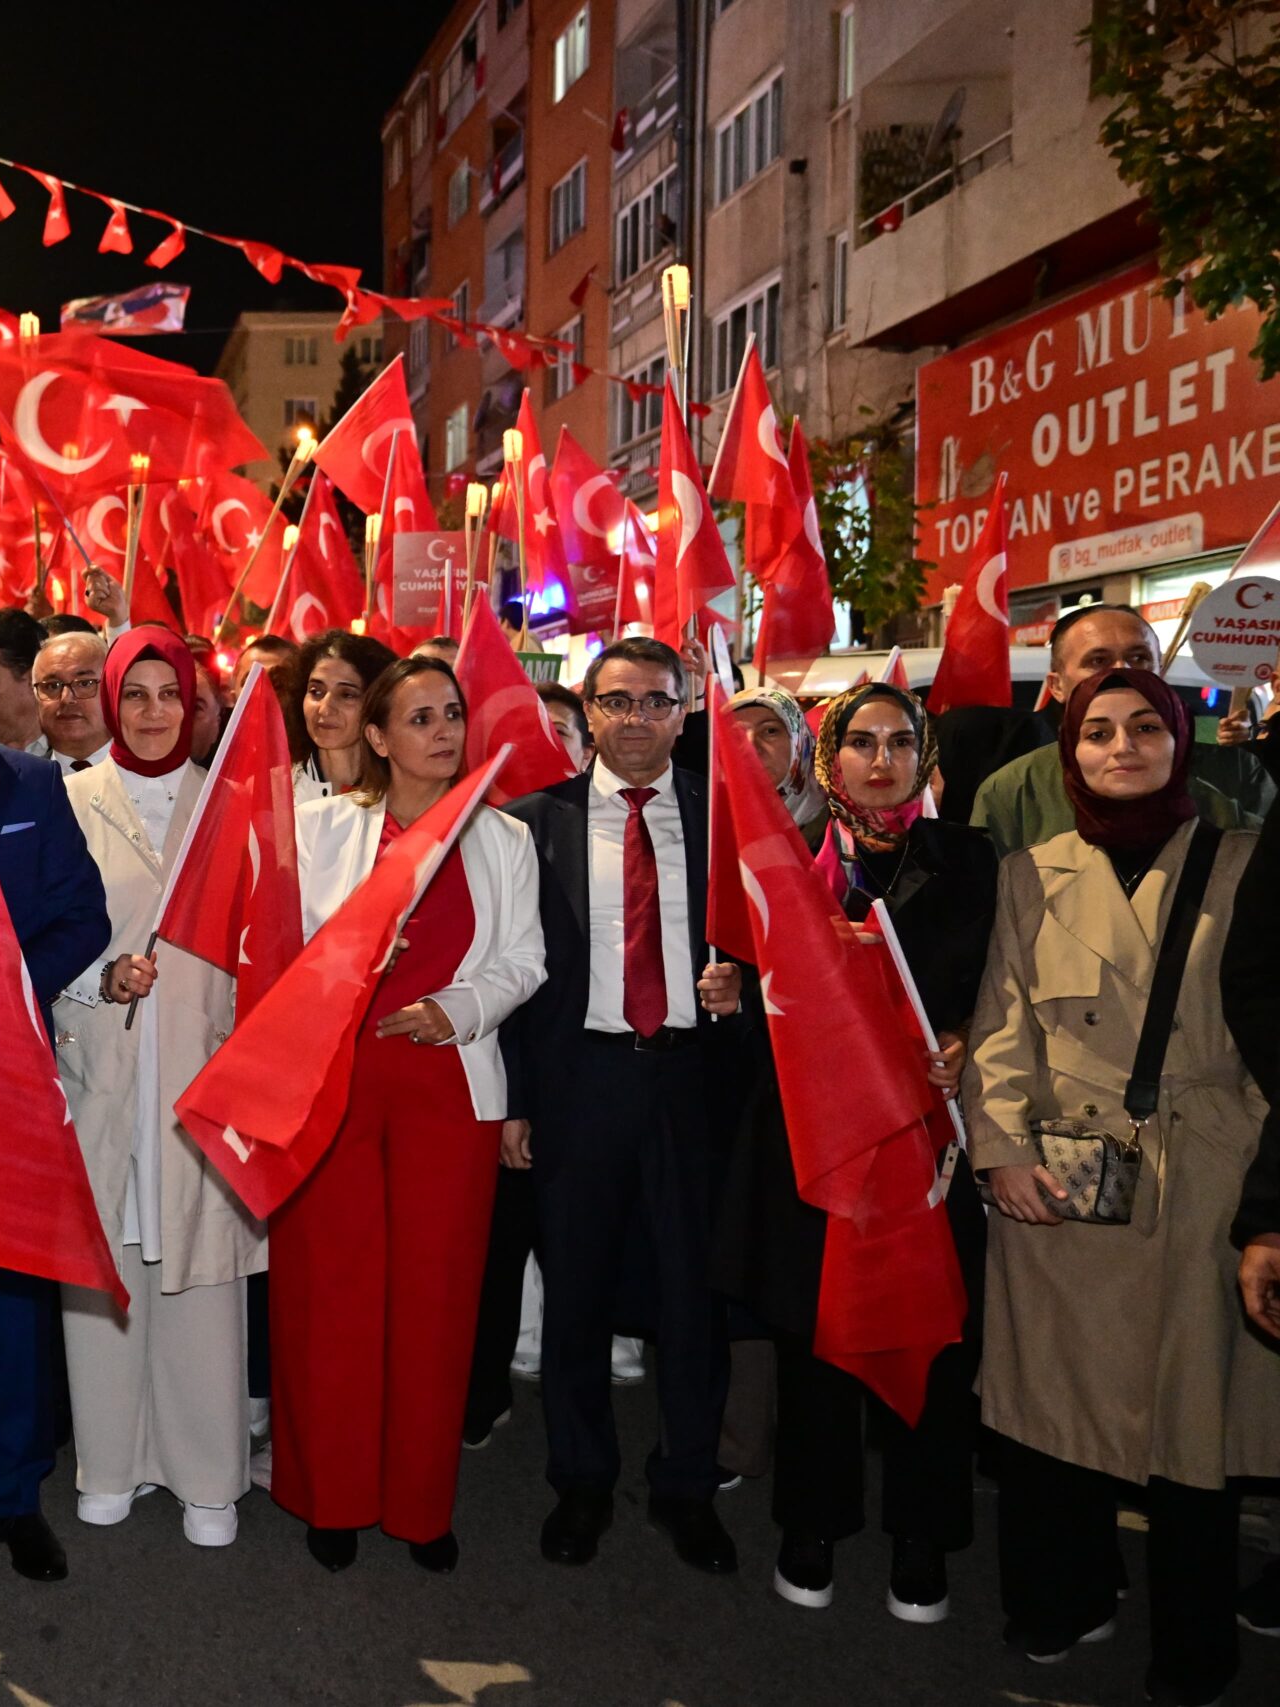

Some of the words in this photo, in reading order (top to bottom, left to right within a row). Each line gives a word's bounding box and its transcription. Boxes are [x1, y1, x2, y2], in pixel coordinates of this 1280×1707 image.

[969, 329, 1055, 417] B&G
[1031, 347, 1235, 468] OUTLET
[934, 488, 1053, 558] TOPAN
[1063, 488, 1101, 527] ve
